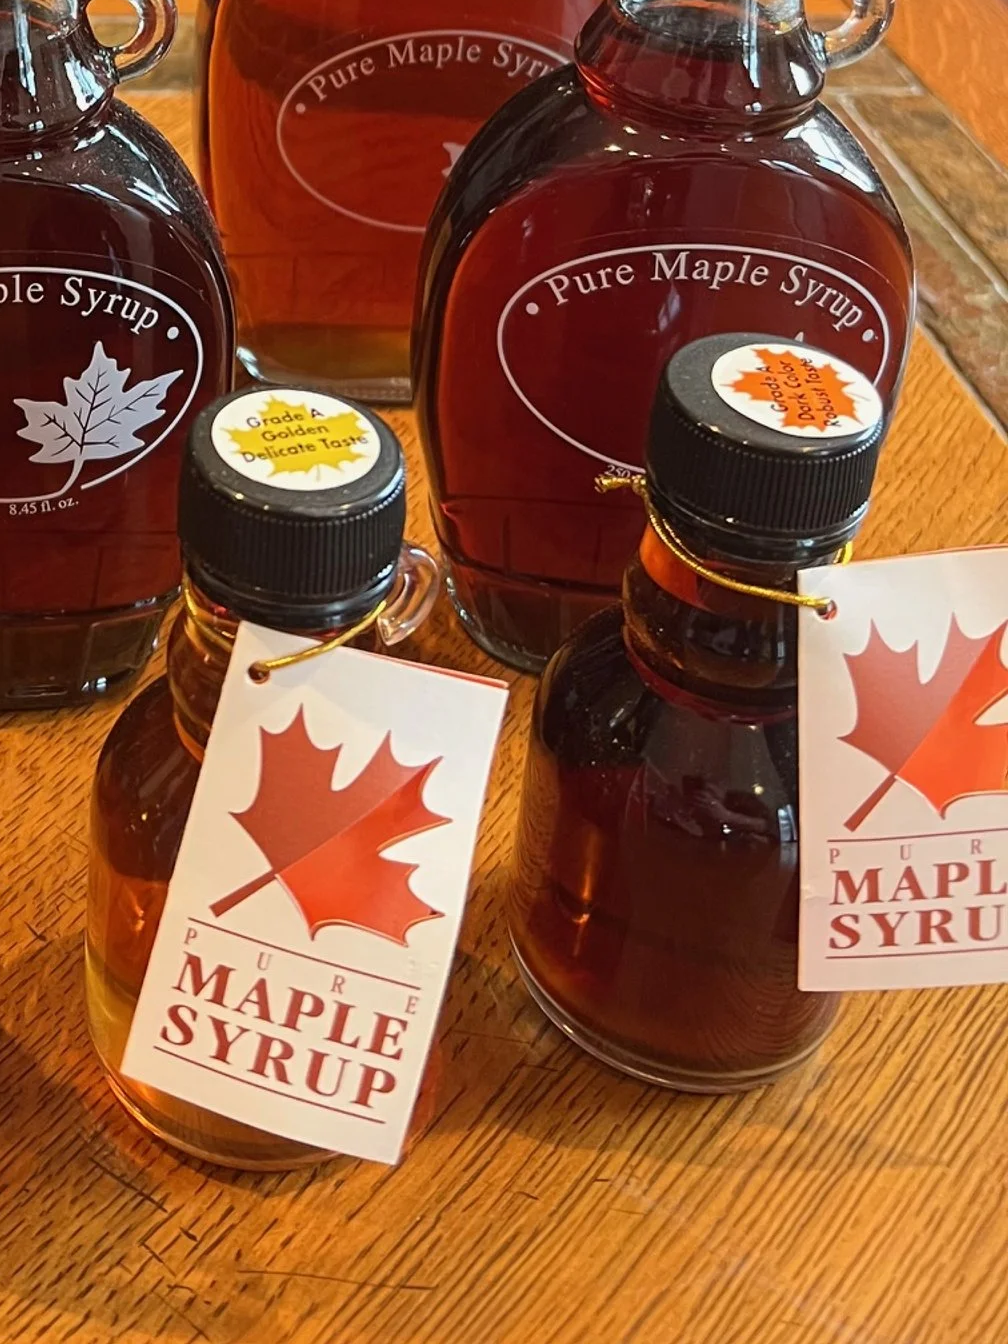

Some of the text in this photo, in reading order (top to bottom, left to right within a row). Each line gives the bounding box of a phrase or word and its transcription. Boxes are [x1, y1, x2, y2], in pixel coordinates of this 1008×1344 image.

[306, 57, 375, 102] Pure
[386, 36, 481, 69] Maple
[60, 275, 160, 334] Syrup
[543, 251, 863, 332] Pure Maple Syrup
[246, 408, 324, 428] Grade A
[756, 365, 789, 413] Grade A
[777, 360, 815, 421] Dark Color
[800, 357, 841, 427] Robust Taste
[241, 434, 369, 463] Delicate Taste
[261, 423, 329, 442] Golden
[9, 503, 38, 516] 8.45
[41, 500, 56, 513] fl.
[58, 497, 79, 509] oz.
[171, 951, 408, 1061] MAPLE
[159, 1004, 397, 1109] SYRUP
